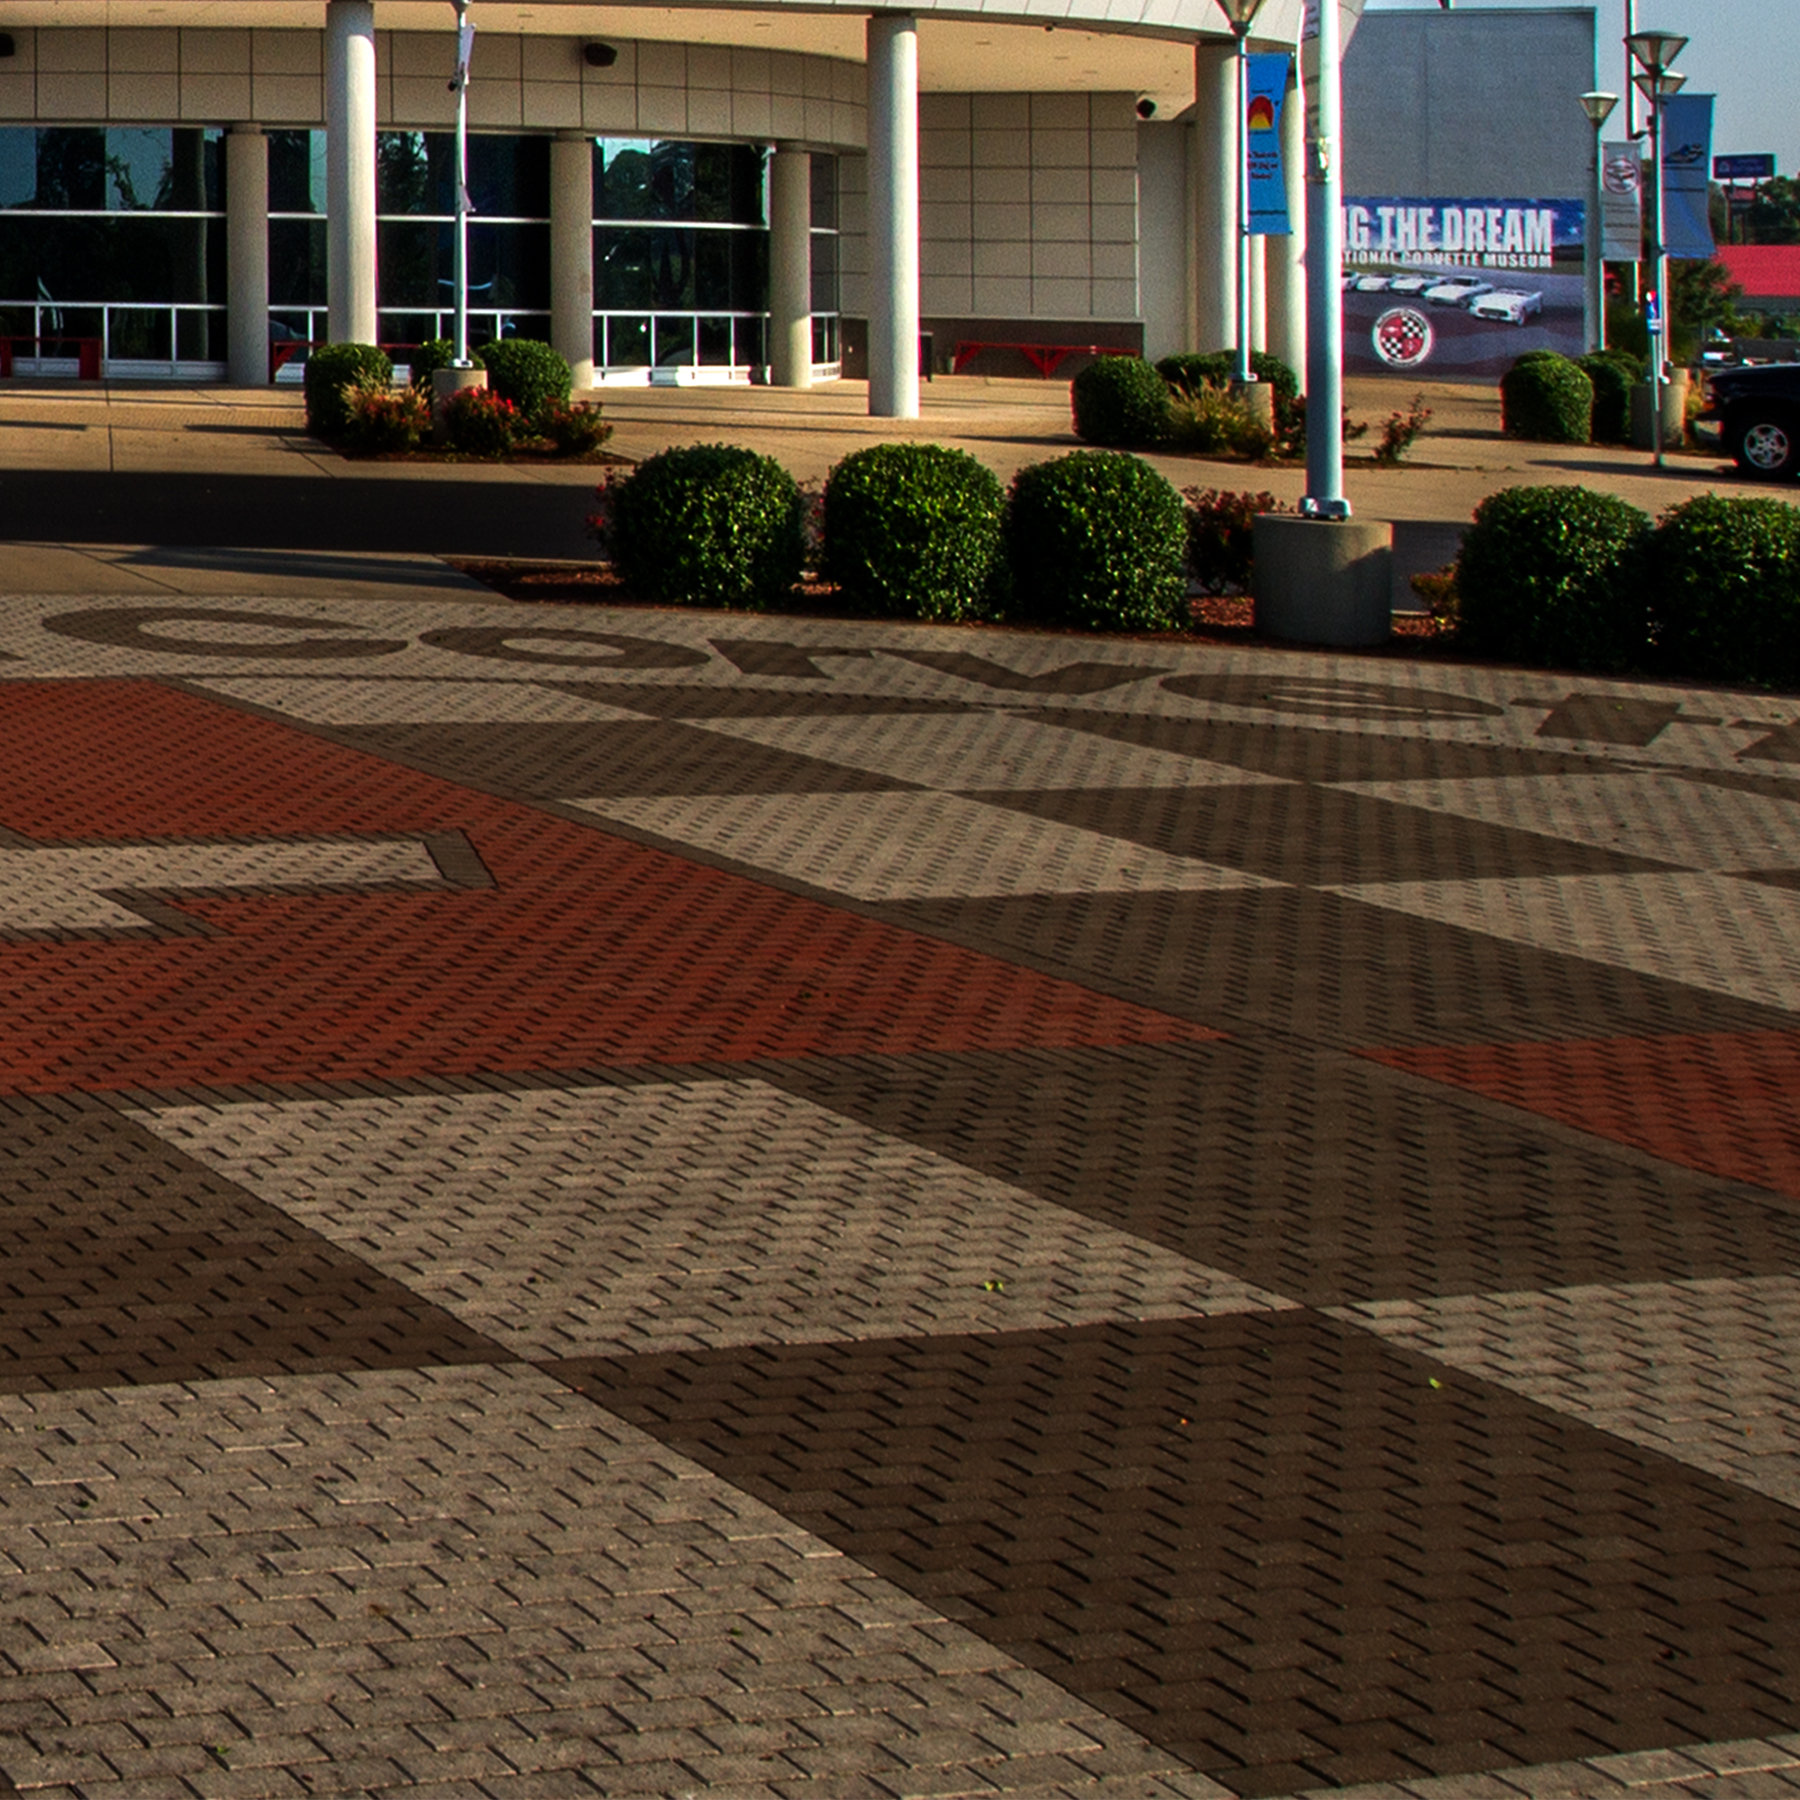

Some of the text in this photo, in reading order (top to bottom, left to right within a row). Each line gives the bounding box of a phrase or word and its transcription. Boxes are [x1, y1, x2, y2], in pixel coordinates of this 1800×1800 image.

[1376, 206, 1435, 250] THE
[1443, 207, 1553, 253] DREAM
[1341, 251, 1553, 269] TIONAL CORVETTE MUSEUM
